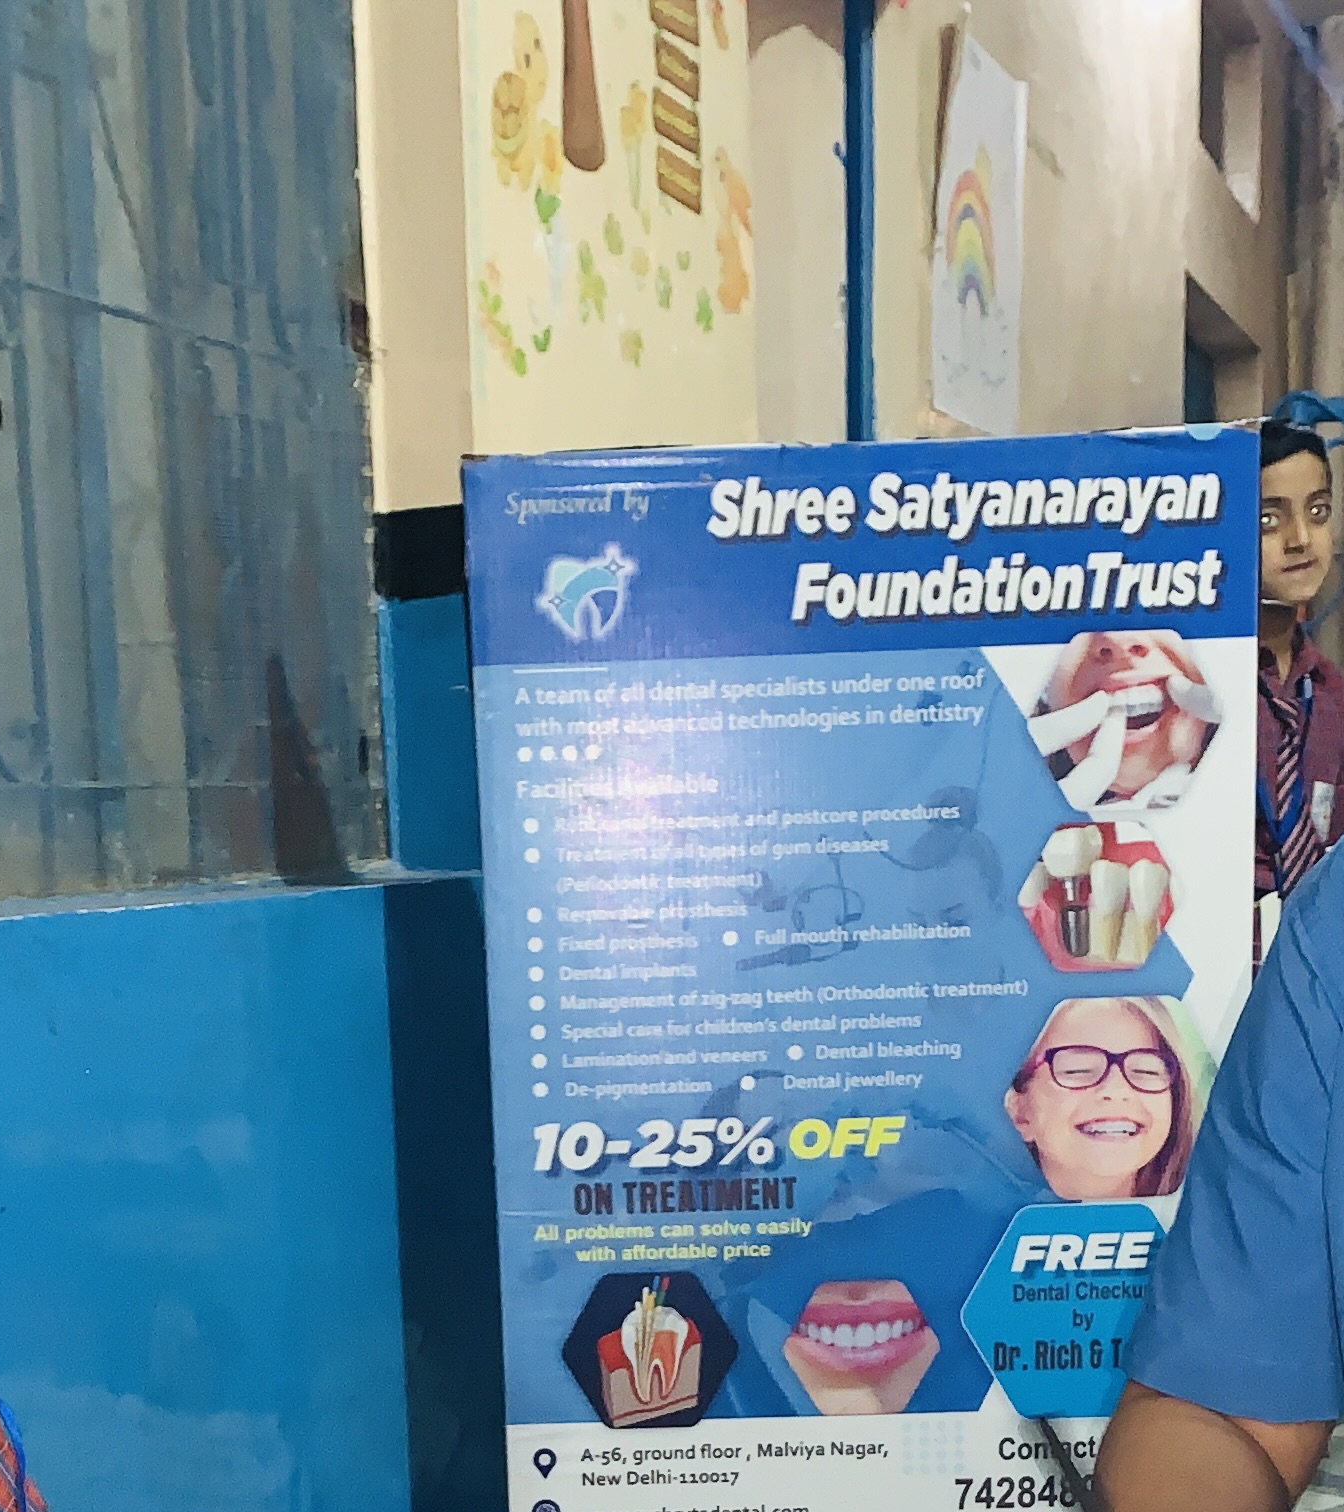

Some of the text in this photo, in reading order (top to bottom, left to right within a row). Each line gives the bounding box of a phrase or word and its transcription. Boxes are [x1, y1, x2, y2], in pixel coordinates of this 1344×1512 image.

[622, 488, 649, 522] by
[707, 470, 1221, 541] Shree Satyanarayan
[515, 668, 984, 705] A team of all dental specialists under one roof
[516, 703, 985, 737] with most advanced technologies in dentistry
[745, 810, 777, 826] and
[782, 809, 859, 830] postcore
[862, 801, 961, 826] procedures
[750, 839, 768, 856] of
[772, 842, 812, 861] gum
[815, 837, 890, 856] diseases
[559, 935, 606, 953] Fixed
[755, 928, 787, 945] Full
[791, 924, 849, 944] mouth
[853, 920, 971, 943] rehabilitation
[559, 961, 698, 982] Dental implants
[560, 978, 1029, 1014] Management of zig-zag teeth (Orthodontic treatment)
[561, 1011, 923, 1044] Special care for children's dental problems
[561, 1039, 962, 1069] Lamination and veneers Dental bleaching
[564, 1069, 924, 1101] De-pigmentation Dental jewellery
[532, 1115, 907, 1172] 10-25% OFF
[573, 1175, 798, 1217] ON TREATMENT
[533, 1216, 813, 1245] All problems can solve easily
[575, 1240, 772, 1264] with affordable price
[1010, 1230, 1156, 1274] FREE
[1012, 1281, 1070, 1303] Dental
[1072, 1308, 1095, 1332] by
[993, 1341, 1028, 1372] Dr.
[1034, 1339, 1083, 1370] Rich
[1089, 1341, 1104, 1369] &
[581, 1446, 628, 1466] A-56,
[632, 1445, 696, 1466] ground
[700, 1442, 743, 1461] floor
[757, 1441, 826, 1463] Malviya
[830, 1440, 889, 1463] Nagar,
[998, 1437, 1097, 1460] Conact
[581, 1468, 741, 1488] New Delhi-110017
